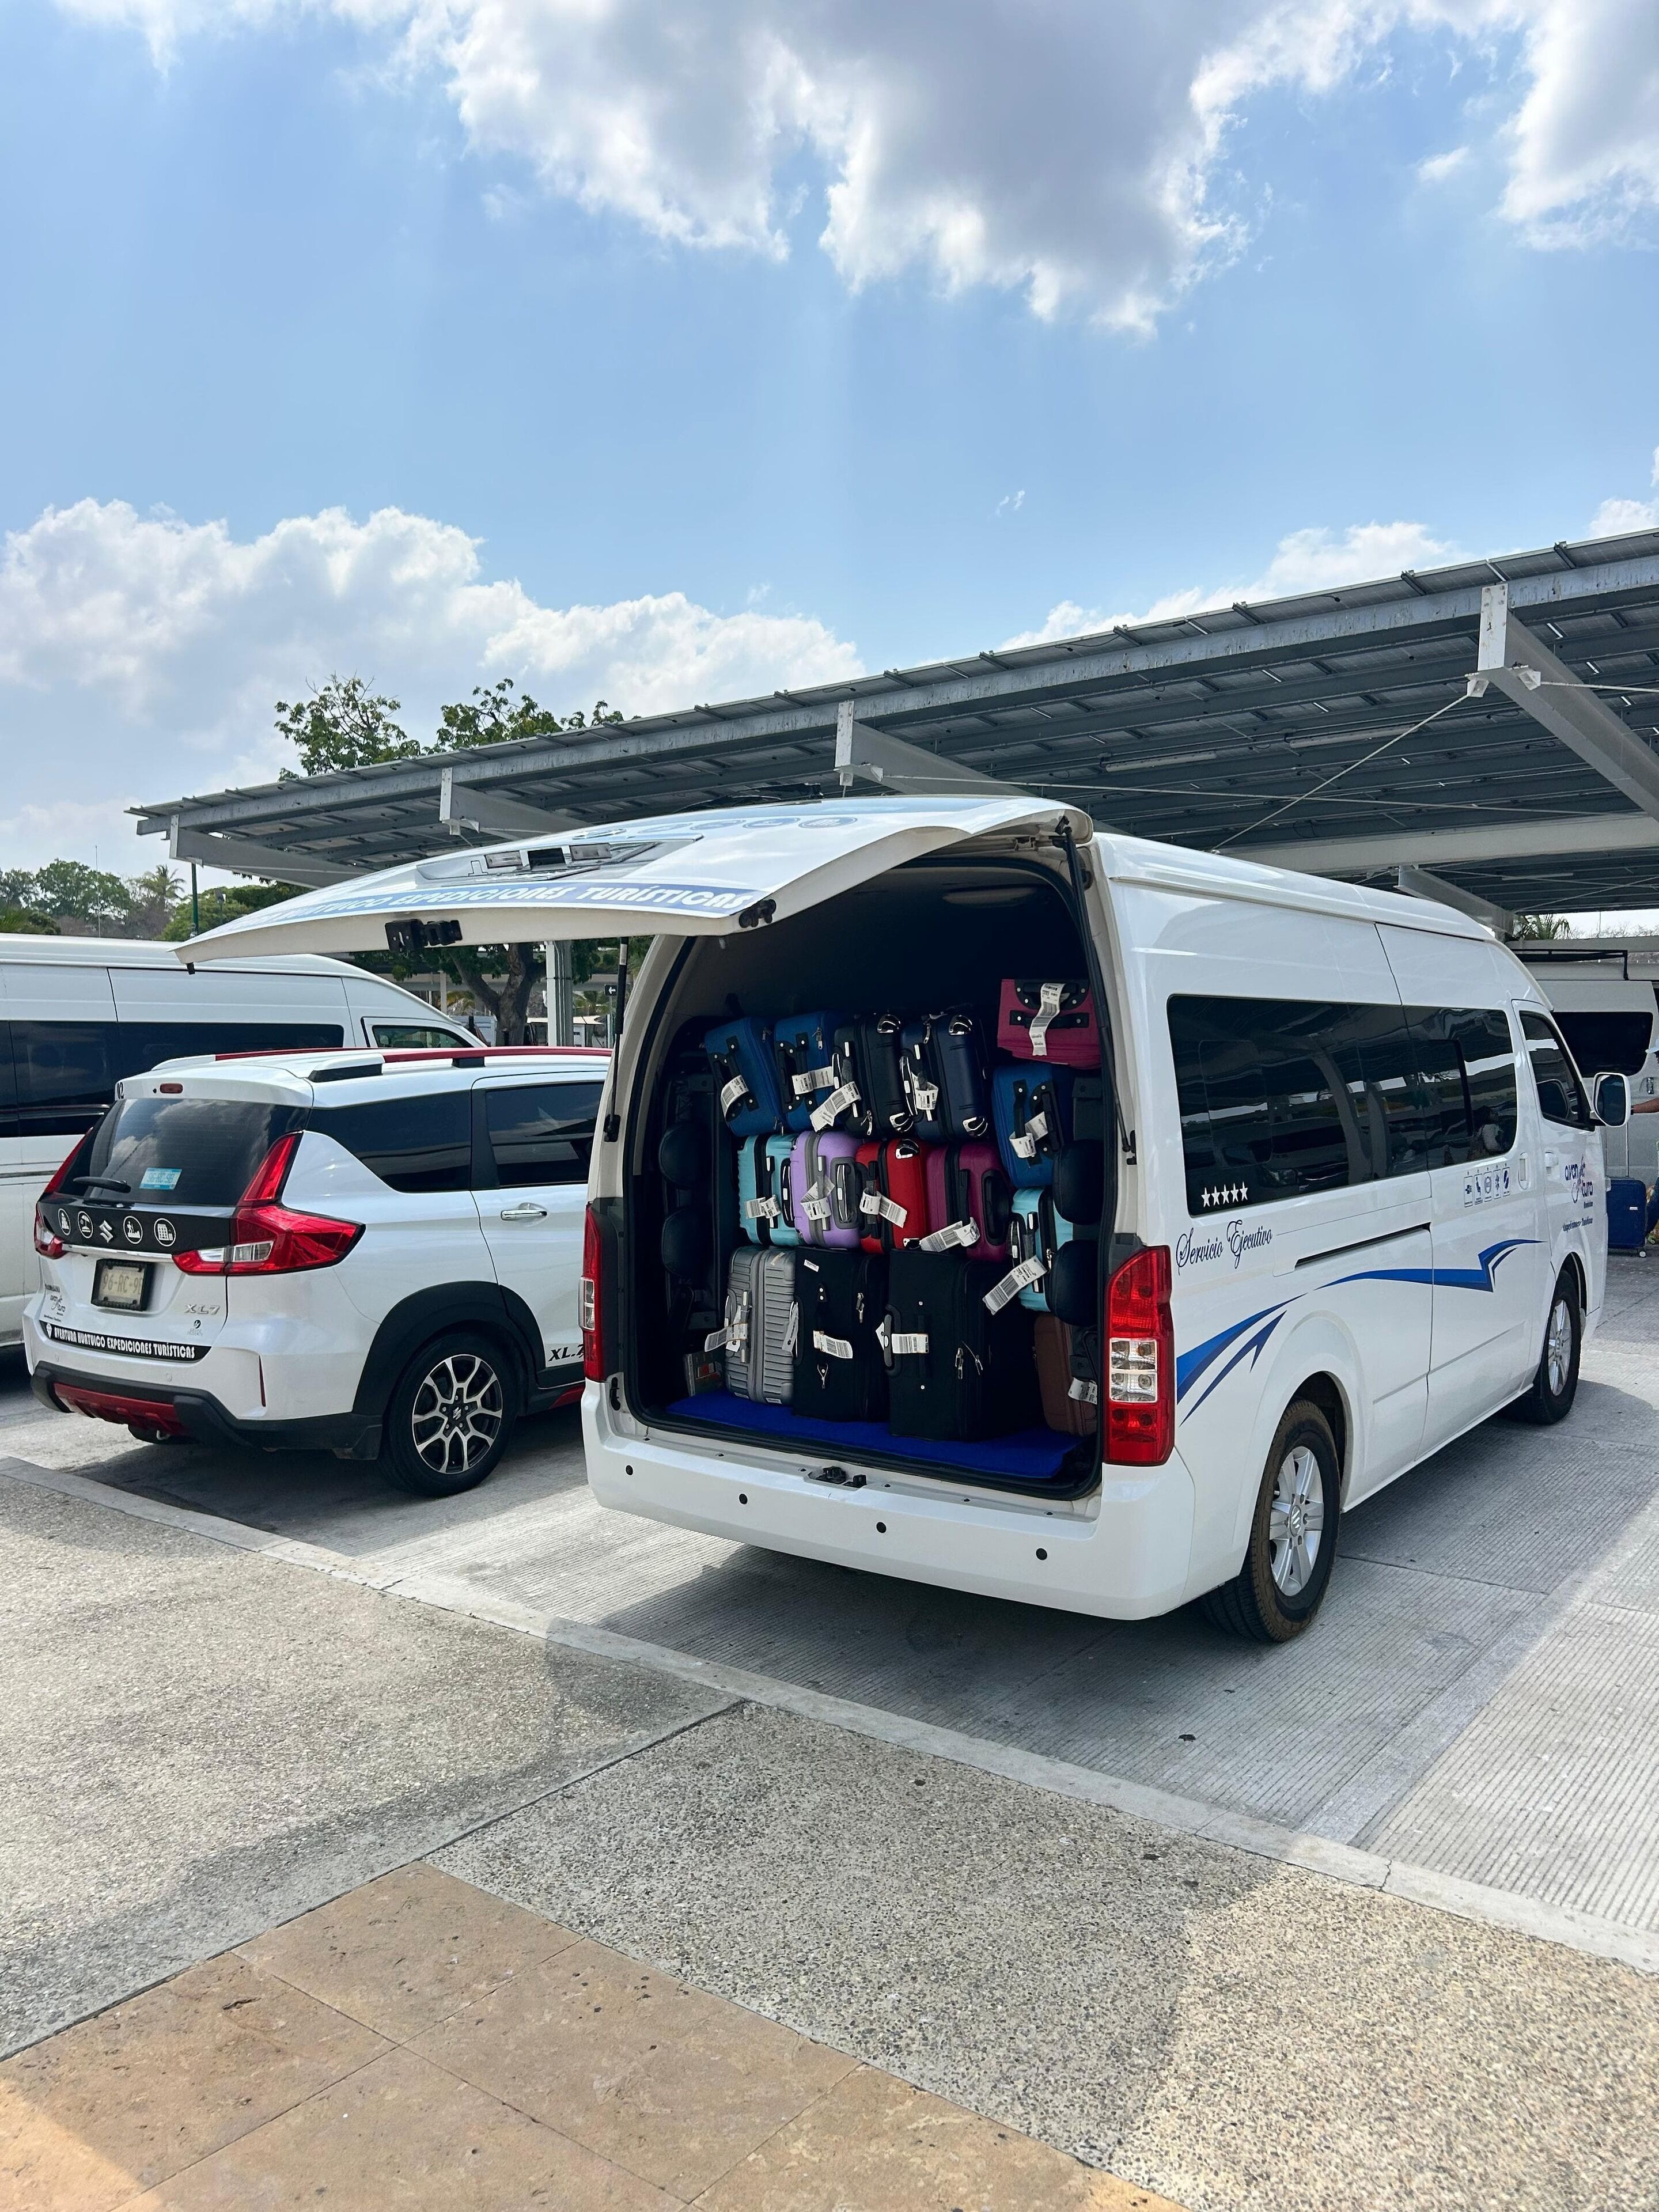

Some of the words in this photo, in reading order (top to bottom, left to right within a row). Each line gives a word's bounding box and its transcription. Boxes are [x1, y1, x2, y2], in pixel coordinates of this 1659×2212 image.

[389, 886, 575, 907] EXPEDICIONES
[577, 886, 753, 909] TURÍSTICAS
[117, 1082, 124, 1099] 02
[1176, 1227, 1224, 1275] Servicio
[1227, 1219, 1272, 1269] Ejecutivo
[184, 1304, 221, 1315] XL7
[107, 1336, 152, 1355] EXPEDICIONES
[153, 1342, 195, 1359] TURÍSTICAS
